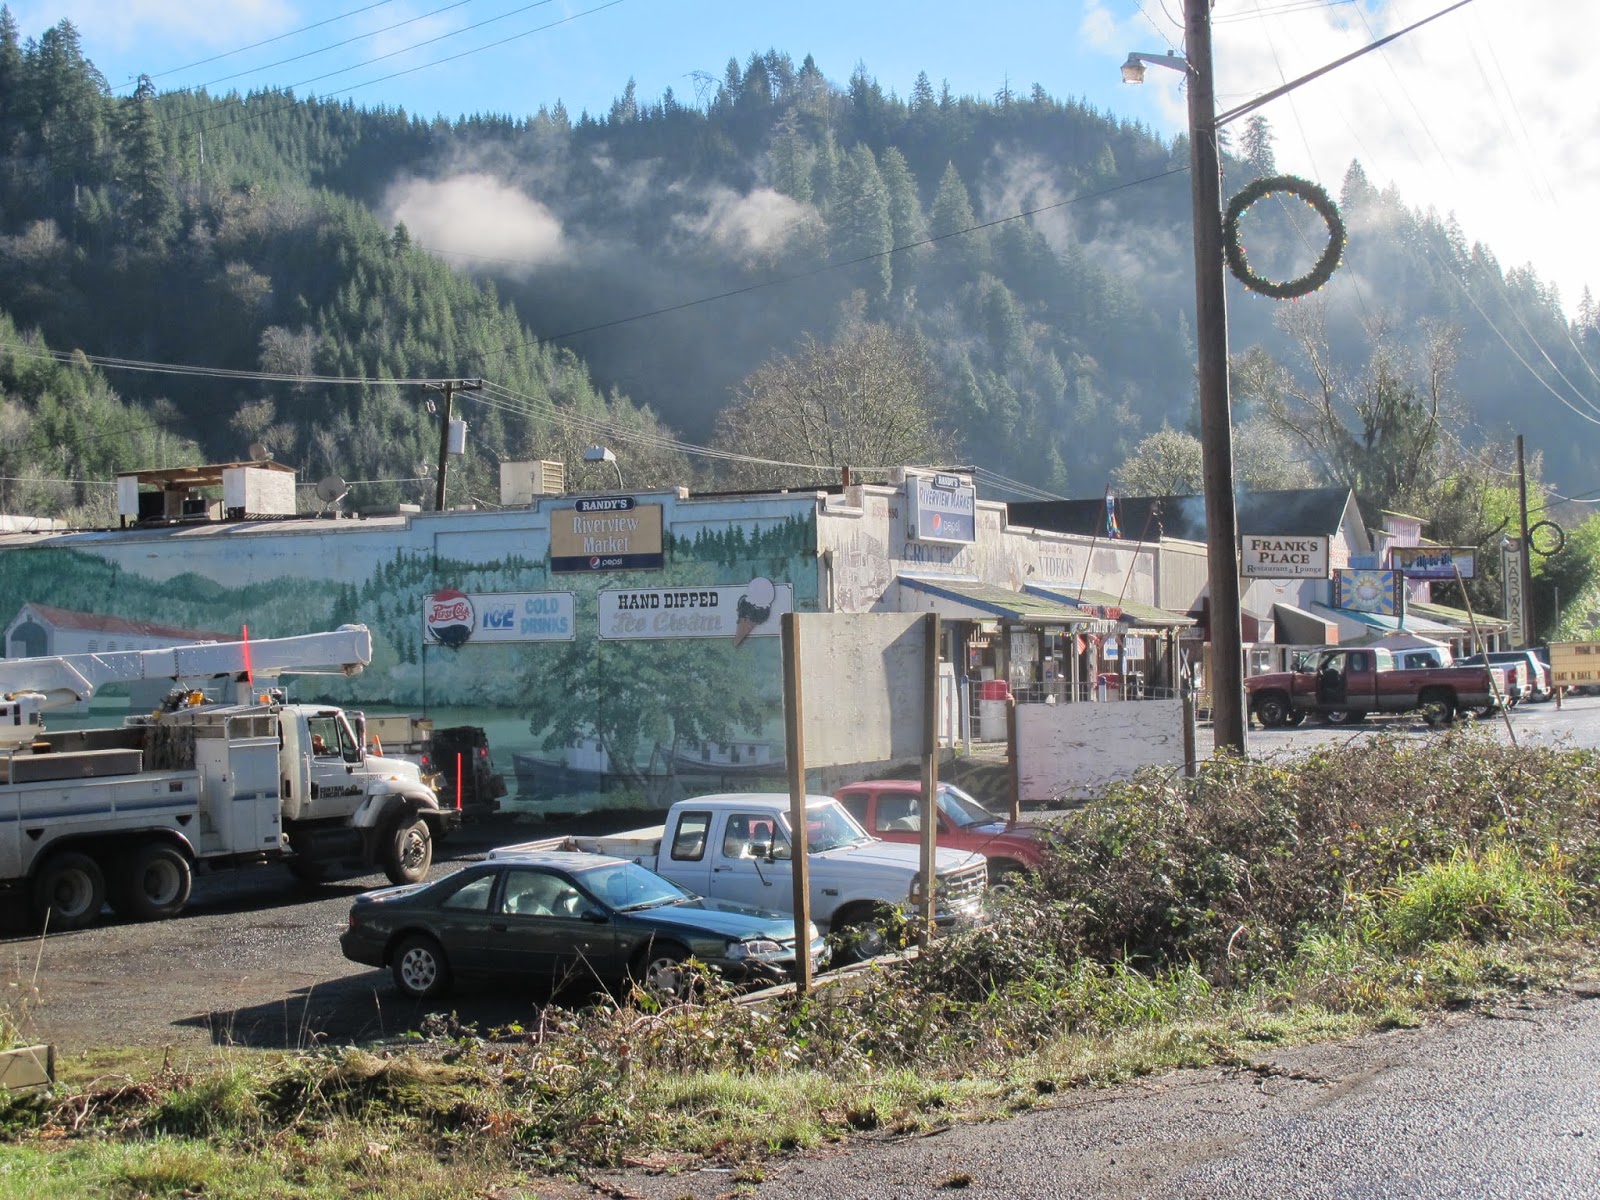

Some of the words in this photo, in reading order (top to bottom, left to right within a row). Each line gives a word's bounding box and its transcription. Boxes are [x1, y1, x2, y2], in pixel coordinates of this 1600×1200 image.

[582, 500, 627, 511] RANDY'S
[920, 487, 949, 507] RIVERVIEW
[951, 491, 973, 510] MARKET
[573, 515, 638, 534] Riverview
[942, 520, 960, 533] pepsi
[583, 536, 629, 553] Market
[1251, 540, 1318, 551] FRANK'S
[602, 558, 623, 567] pepsi
[1039, 556, 1074, 577] VIDEOS
[1259, 552, 1310, 564] PLACE
[1247, 564, 1288, 573] Restaurant
[1295, 565, 1322, 574] Lounge
[618, 593, 659, 610] HAND
[664, 591, 719, 608] DIPPED
[1508, 556, 1521, 639] HARDWARE
[525, 598, 559, 615] COLD
[482, 603, 516, 629] ICE
[611, 612, 647, 634] Ice
[652, 610, 723, 632] Cream
[520, 616, 568, 634] DRINKS
[320, 785, 345, 794] CENTRAL
